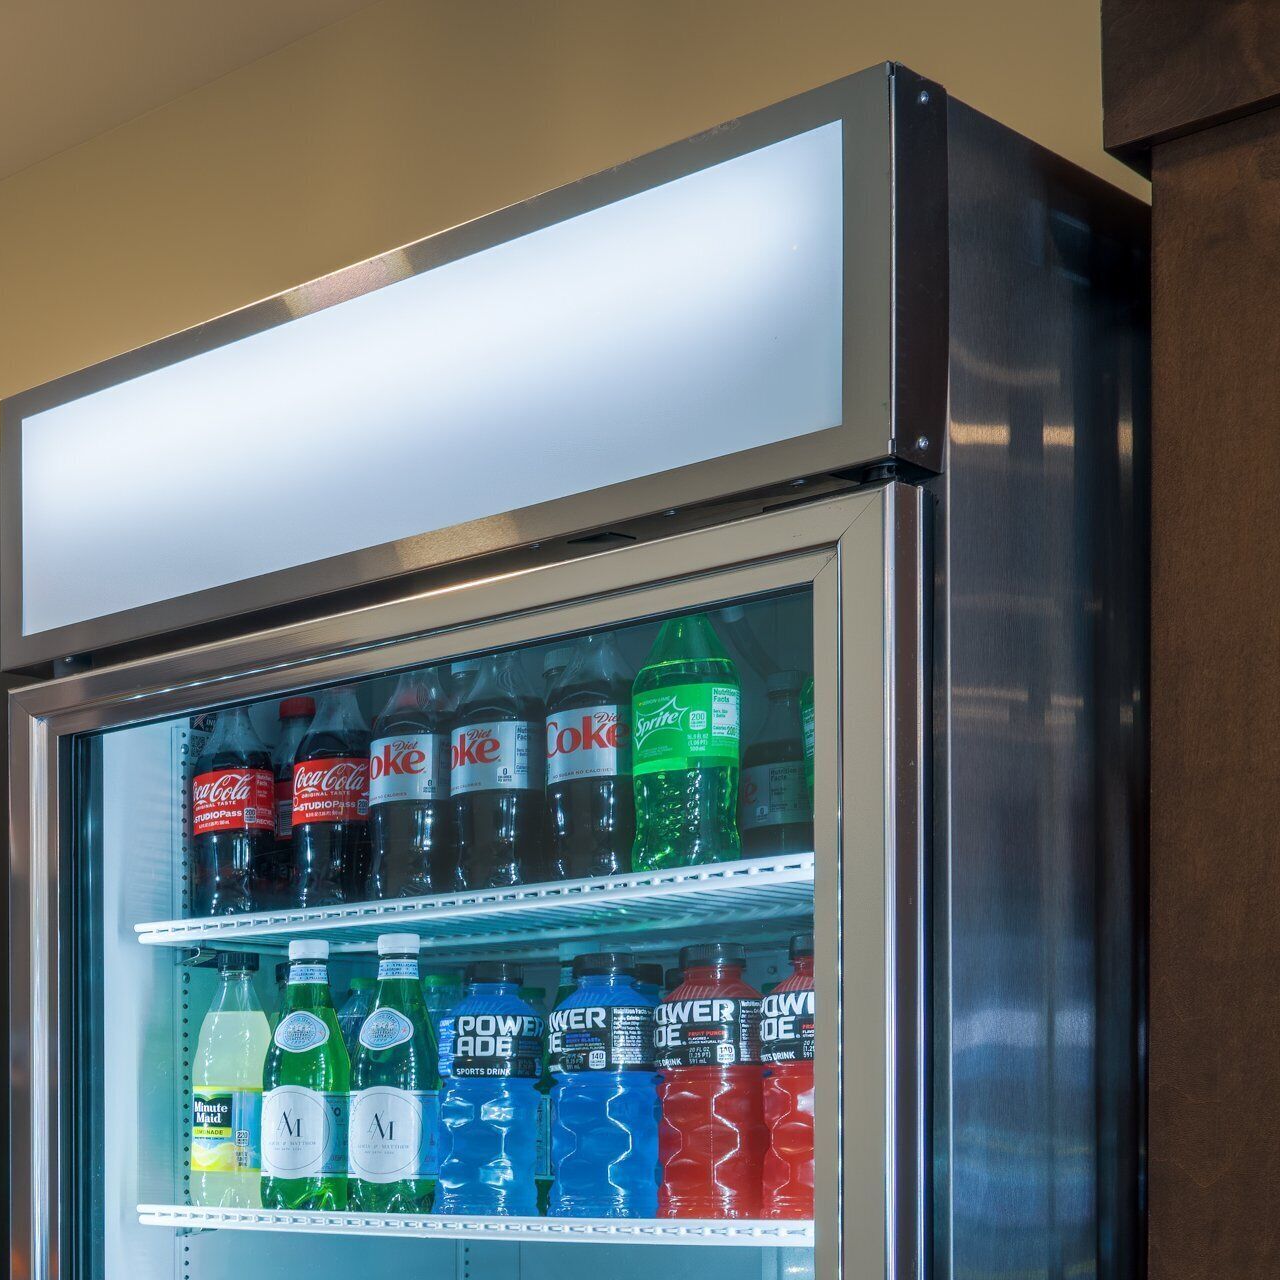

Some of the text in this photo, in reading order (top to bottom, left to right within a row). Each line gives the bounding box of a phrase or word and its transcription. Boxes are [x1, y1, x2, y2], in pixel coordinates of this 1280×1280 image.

[593, 711, 622, 724] Diet
[635, 711, 679, 737] Sprite
[466, 727, 493, 741] Diet
[546, 715, 631, 759] Coke
[392, 738, 419, 751] Diet
[294, 762, 368, 796] Coca-Cola
[245, 809, 256, 817] 200
[458, 1015, 543, 1037] POWER
[457, 1036, 513, 1057] ADE
[773, 1051, 794, 1061] DRINK
[456, 1068, 511, 1076] SPORTS DRINK
[194, 1101, 228, 1114] Minute
[196, 1112, 222, 1124] Maid
